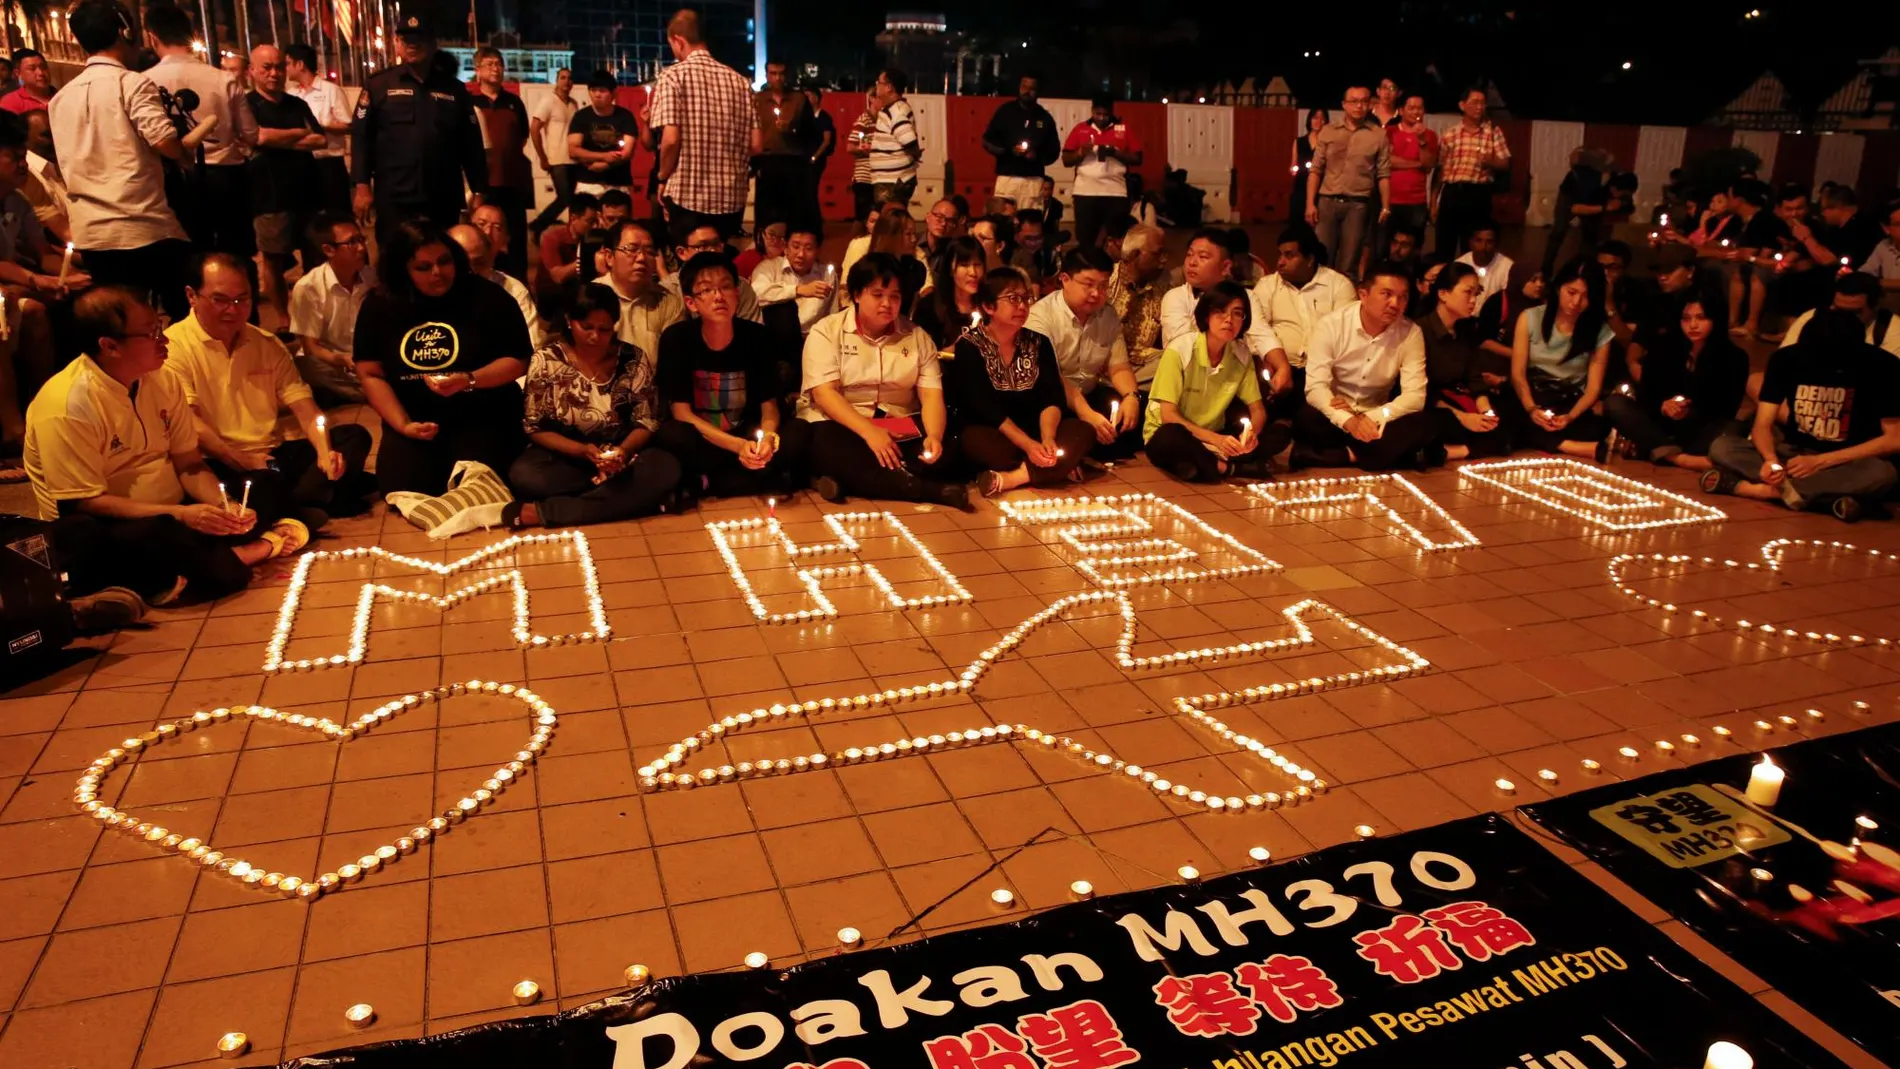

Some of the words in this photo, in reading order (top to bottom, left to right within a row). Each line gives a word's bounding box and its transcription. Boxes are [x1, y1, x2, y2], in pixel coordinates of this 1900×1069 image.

[415, 328, 447, 342] Unite
[412, 347, 450, 361] MH370
[1795, 384, 1847, 403] DEMO
[1794, 399, 1844, 418] CRACY
[1795, 414, 1841, 439] DEAD
[604, 951, 1105, 1069] Doakan
[1114, 850, 1477, 963] MH370
[1152, 952, 1345, 1039] 等待
[1351, 900, 1538, 985] 祈福
[1368, 975, 1524, 1041] Pesawat
[1511, 946, 1629, 998] MH370
